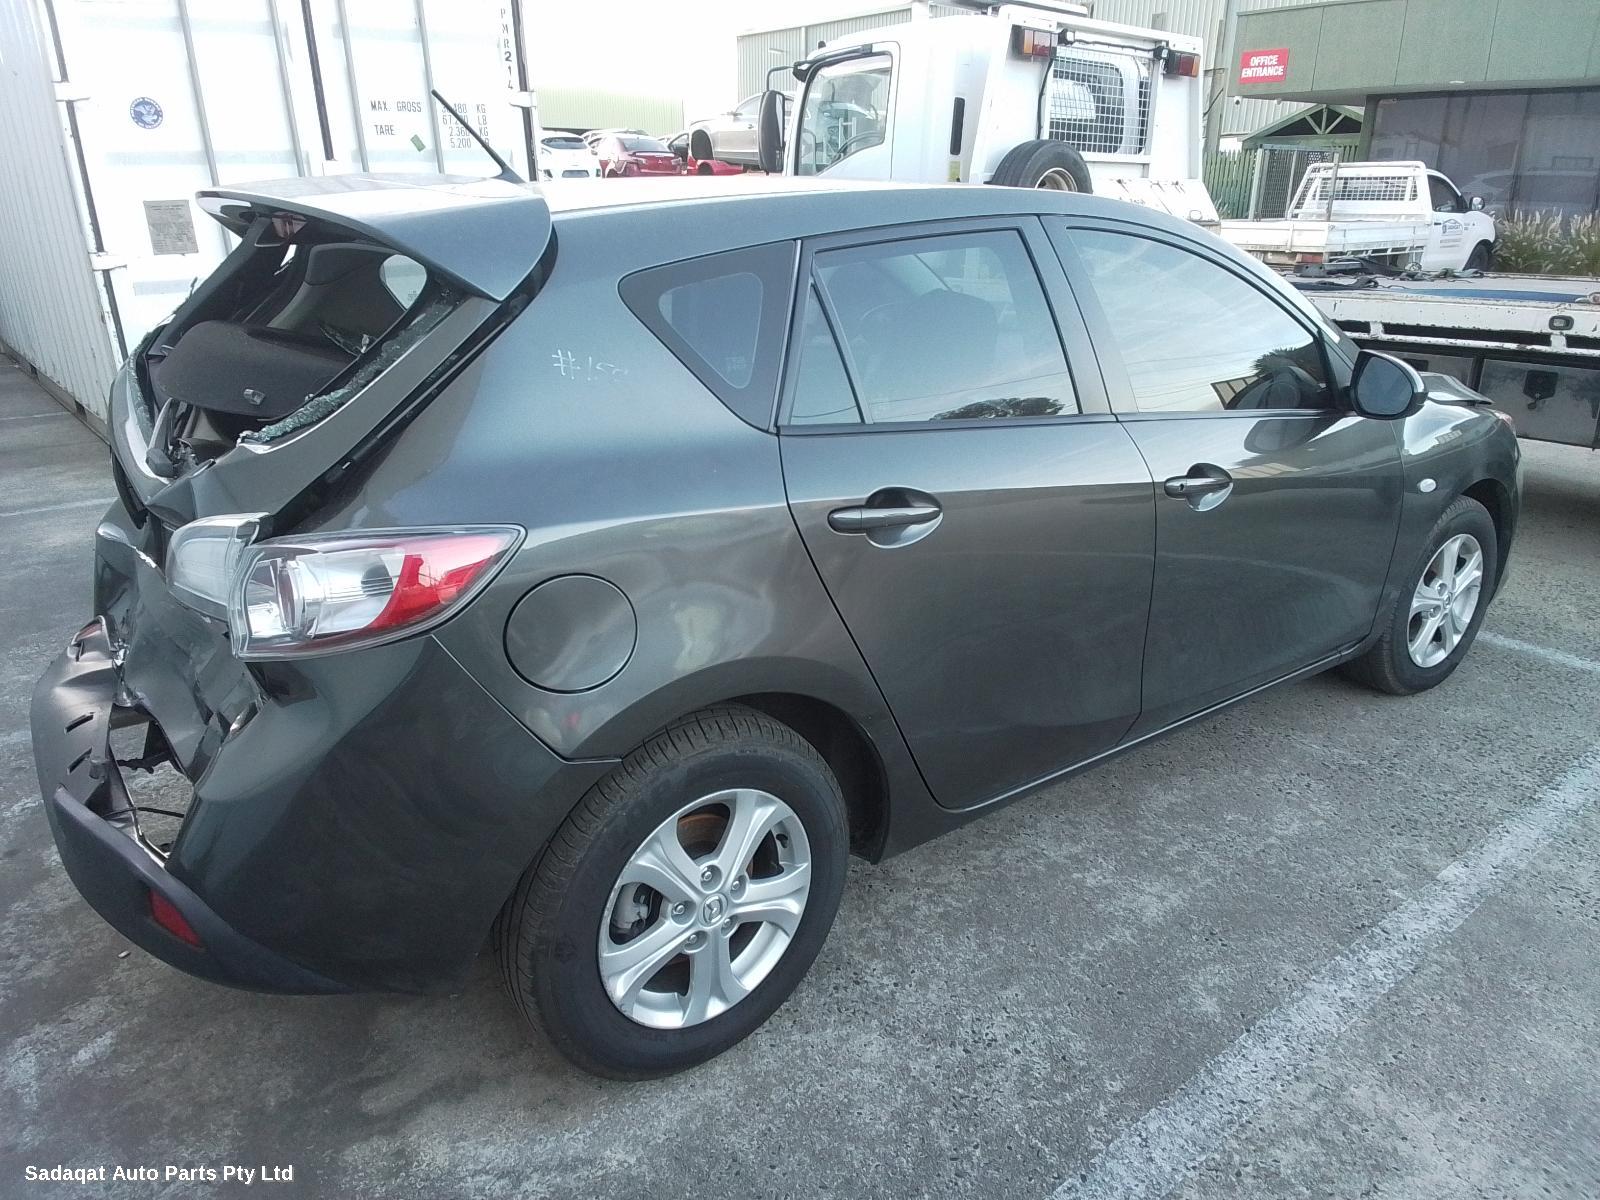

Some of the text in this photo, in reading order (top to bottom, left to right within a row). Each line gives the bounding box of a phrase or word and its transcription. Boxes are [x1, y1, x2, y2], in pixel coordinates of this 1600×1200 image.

[1250, 55, 1279, 66] OFFICE
[1241, 66, 1284, 78] ENTRANCE
[370, 99, 391, 112] MAX.
[397, 101, 421, 113] GROSS
[476, 103, 486, 114] KG
[477, 114, 487, 126] LB
[374, 124, 396, 136] TARE
[478, 126, 489, 137] KG
